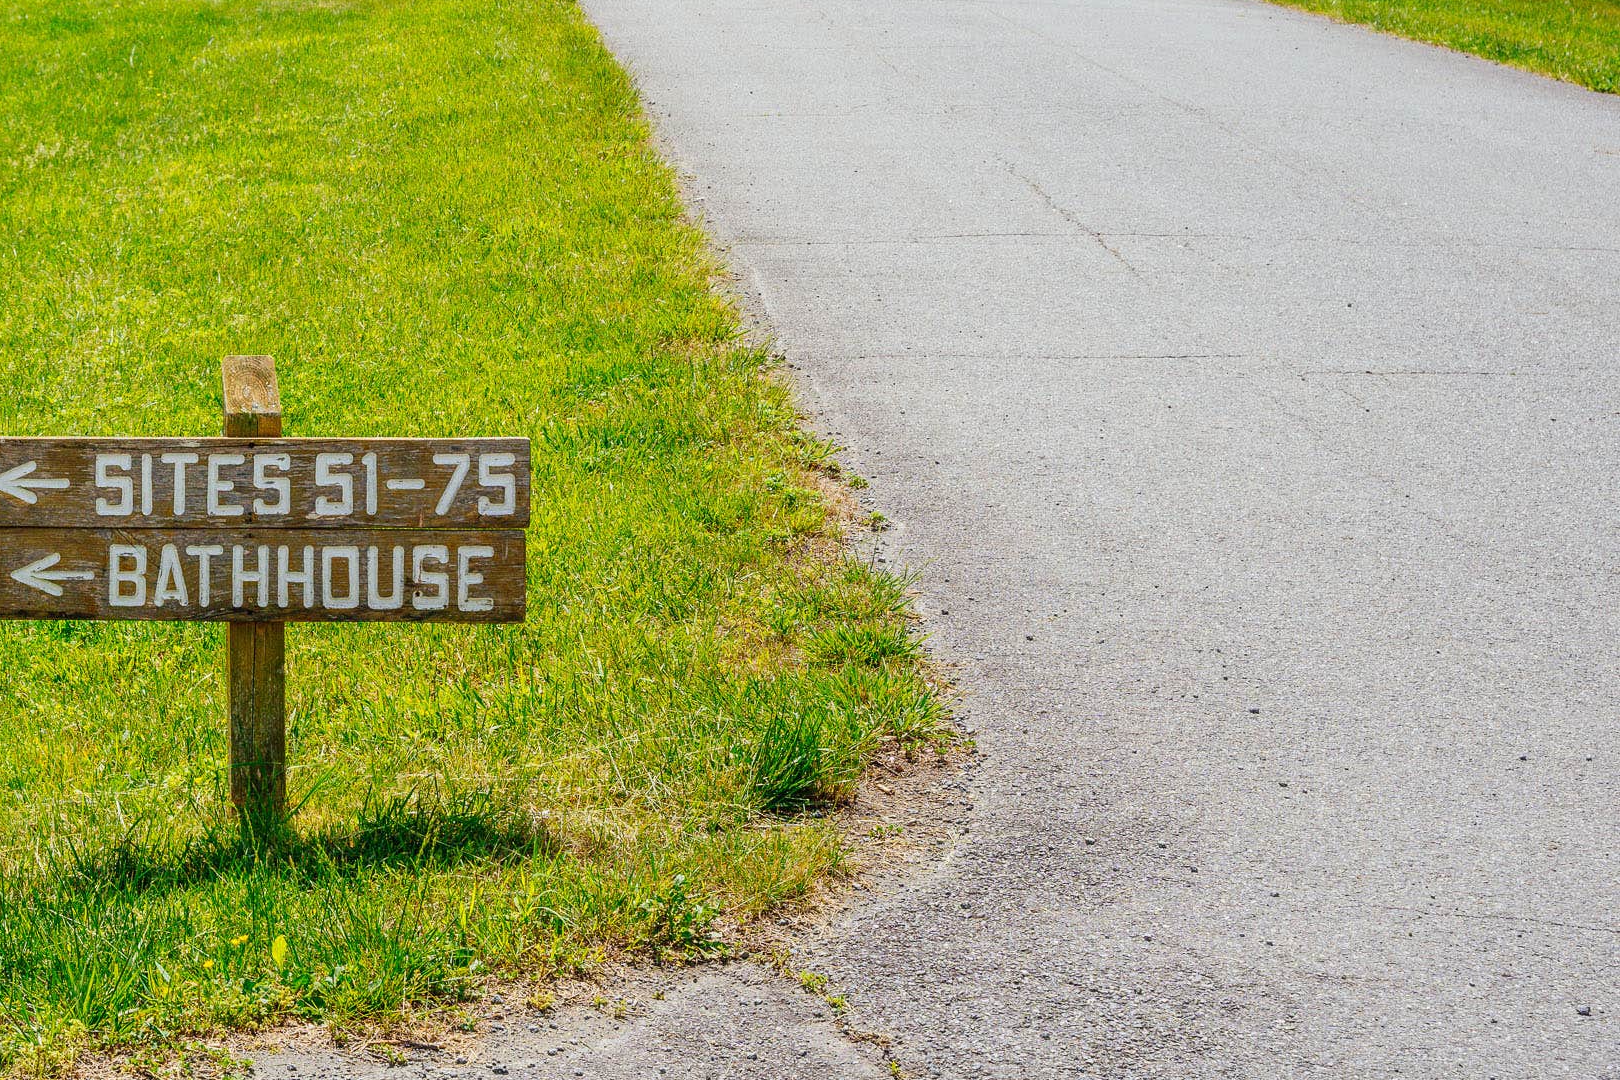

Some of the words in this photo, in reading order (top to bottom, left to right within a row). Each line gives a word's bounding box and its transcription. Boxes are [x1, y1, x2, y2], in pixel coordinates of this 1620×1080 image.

[95, 453, 291, 516] SITES
[315, 453, 516, 516] 51-75
[108, 544, 494, 612] BATHHOUSE
